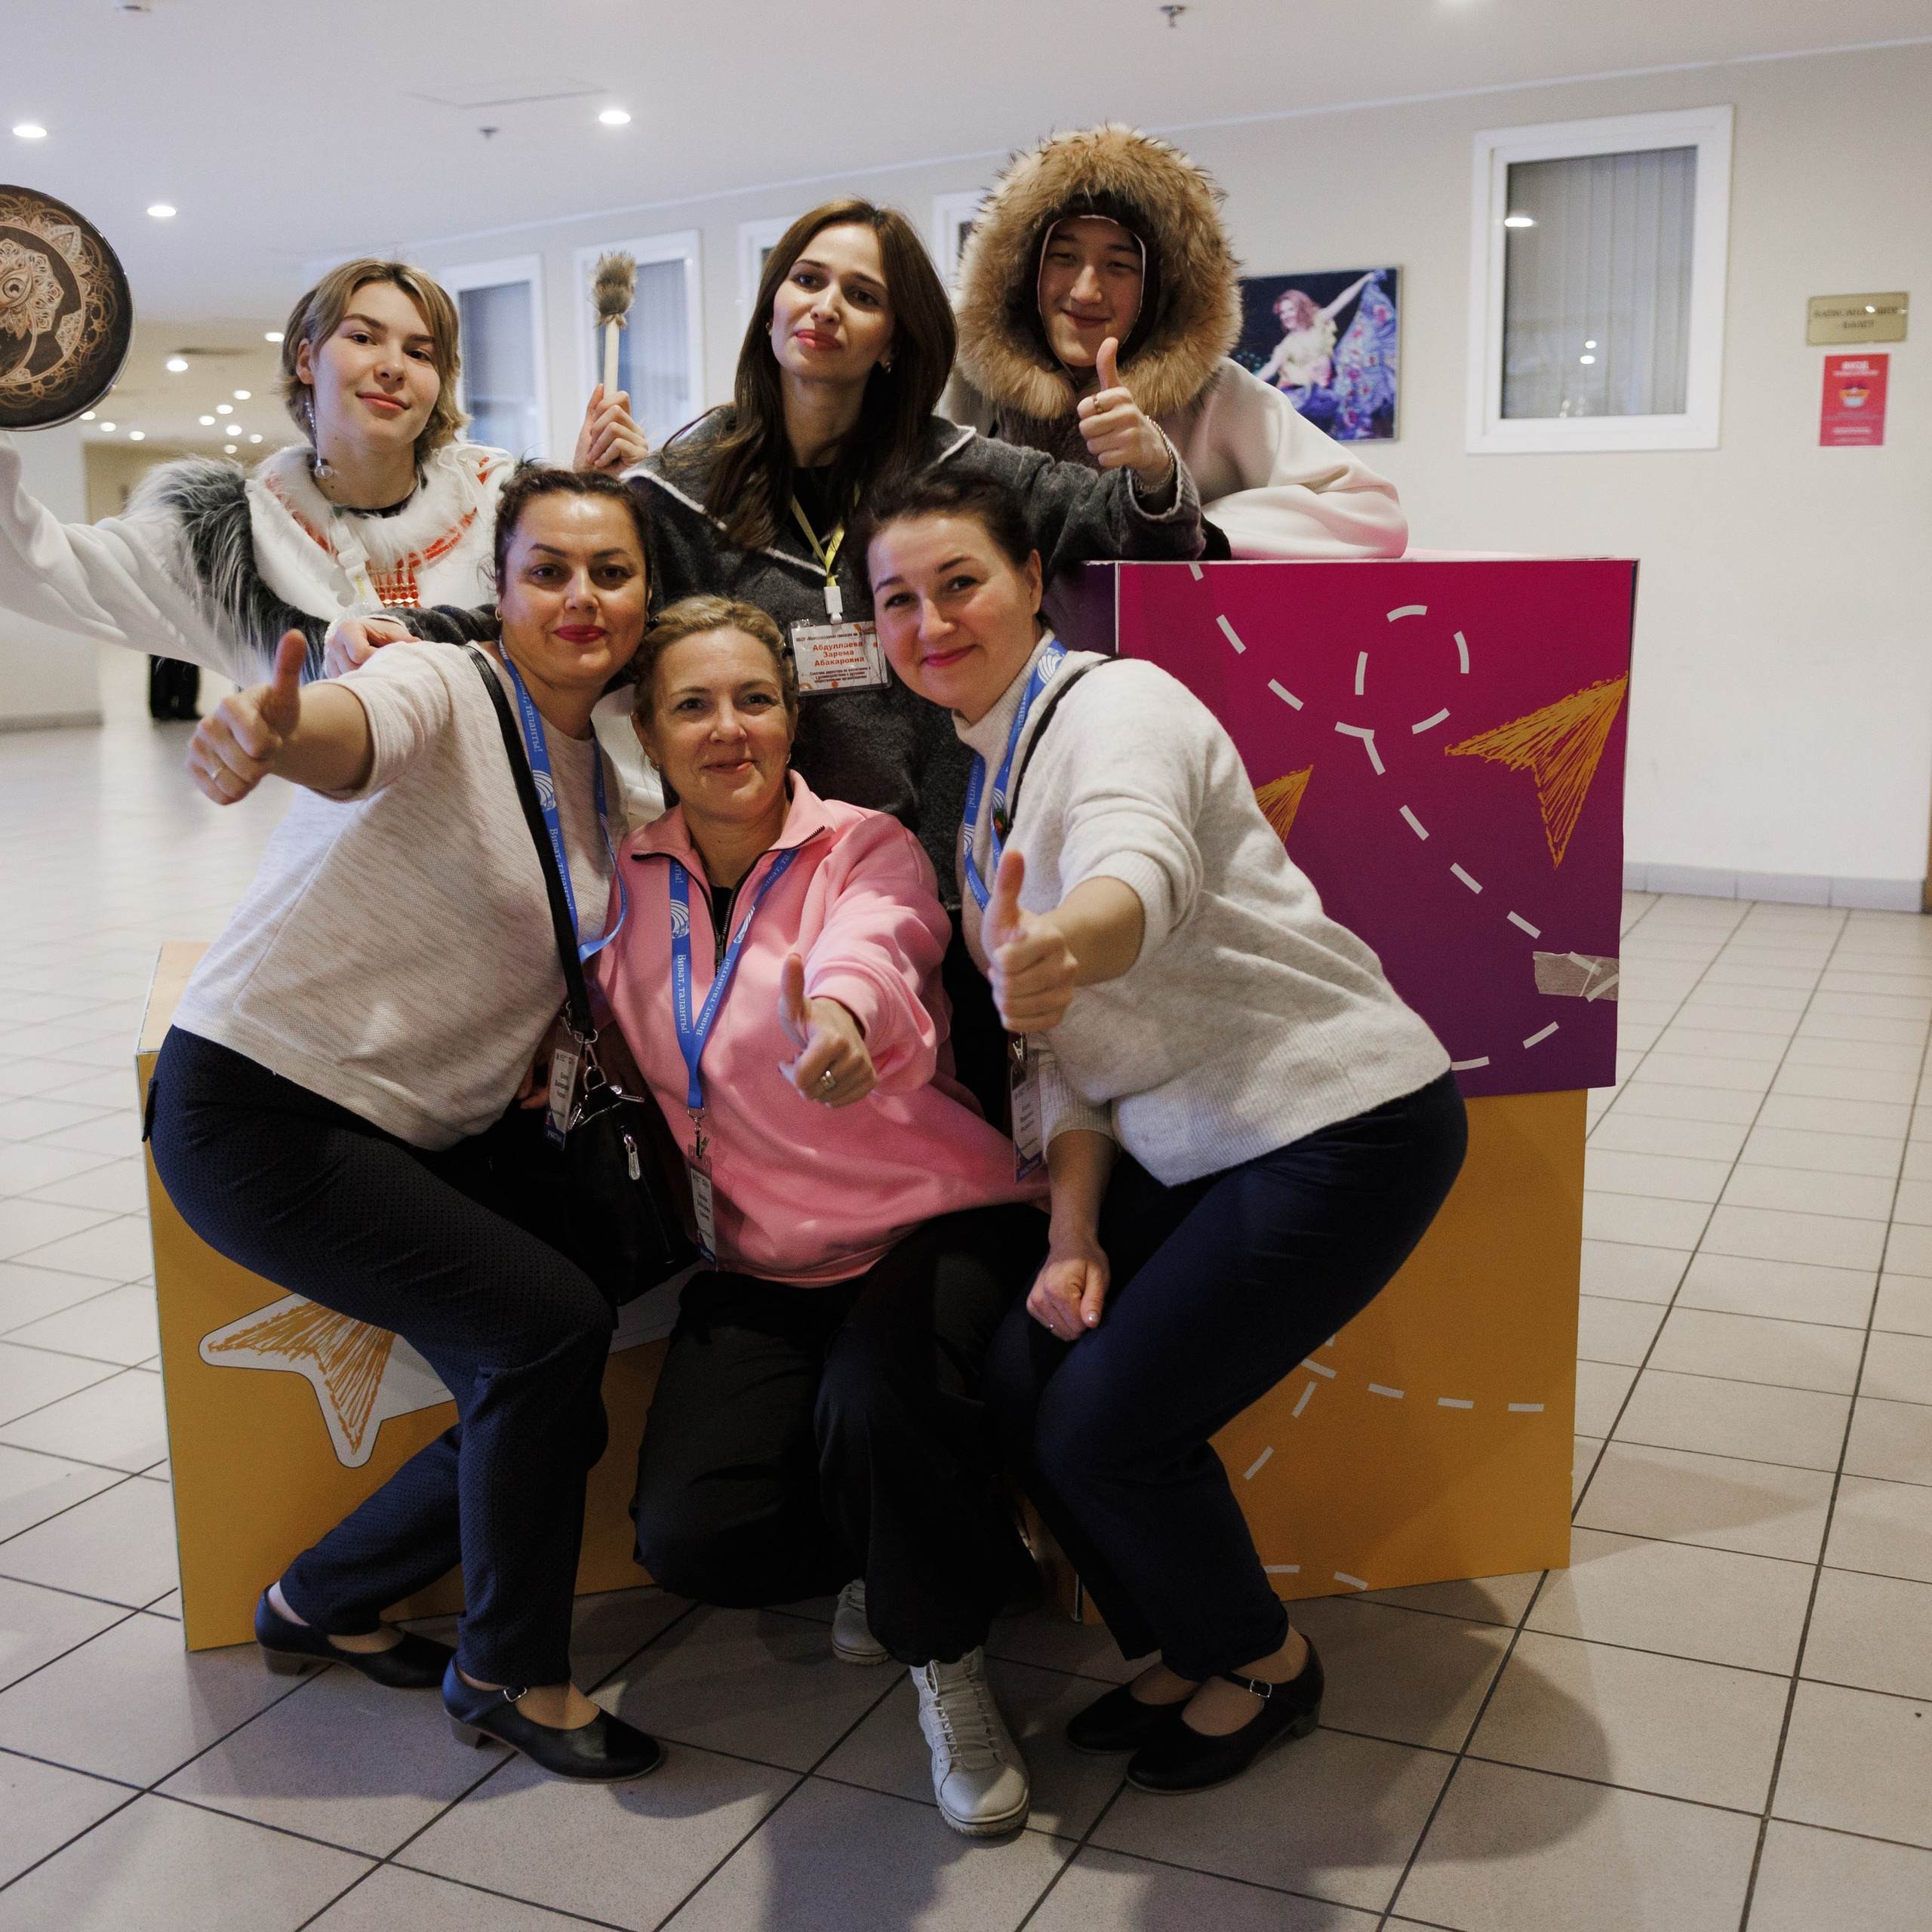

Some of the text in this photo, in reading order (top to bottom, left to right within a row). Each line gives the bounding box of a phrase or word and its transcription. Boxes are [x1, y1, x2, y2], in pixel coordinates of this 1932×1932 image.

[813, 641, 863, 651] Абдуллаева
[814, 657, 864, 666] Абакаровна
[525, 704, 543, 752] таланты!
[677, 954, 690, 1034] Виват, таланты!
[696, 958, 731, 1036] Виват, таланты!
